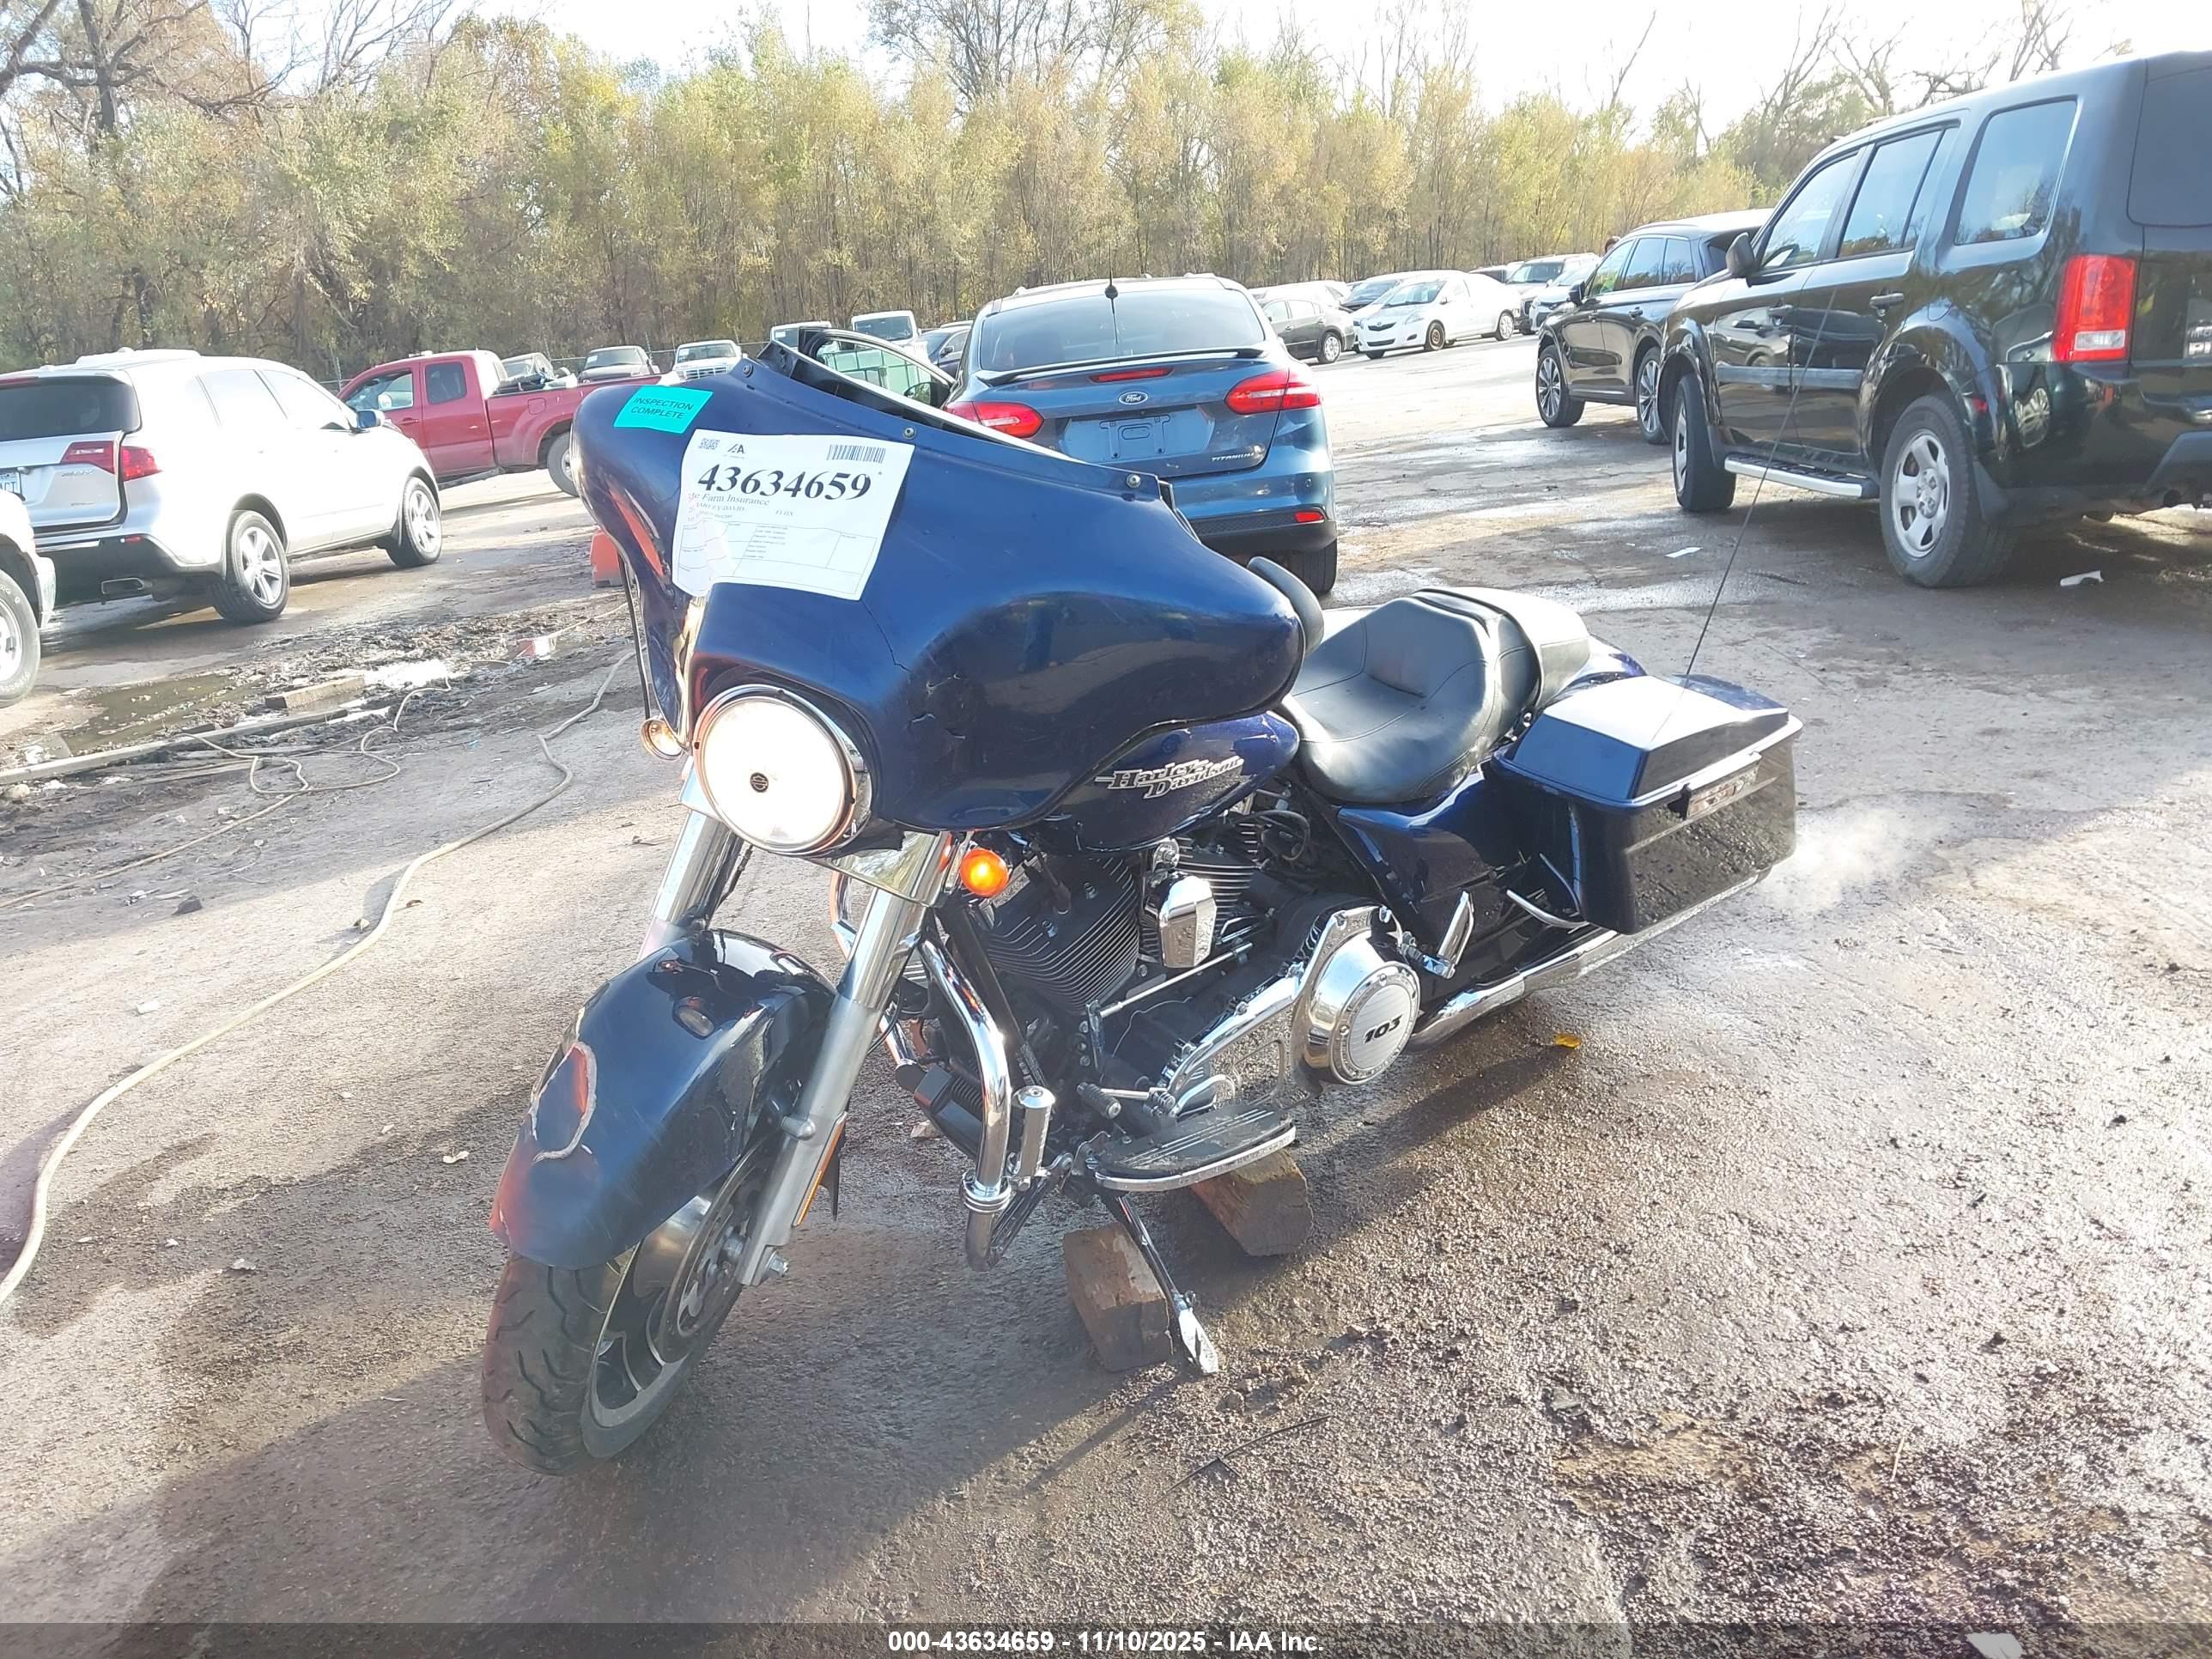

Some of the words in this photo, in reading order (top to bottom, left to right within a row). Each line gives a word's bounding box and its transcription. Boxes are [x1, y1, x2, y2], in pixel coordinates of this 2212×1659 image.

[632, 397, 696, 411] INSPECTION
[630, 406, 686, 420] COMPLETE
[1211, 452, 1255, 462] TITANIUM
[697, 464, 872, 501] 43634659
[702, 493, 725, 502] Farm
[726, 494, 770, 506] Insurance
[1363, 1013, 1403, 1045] 103
